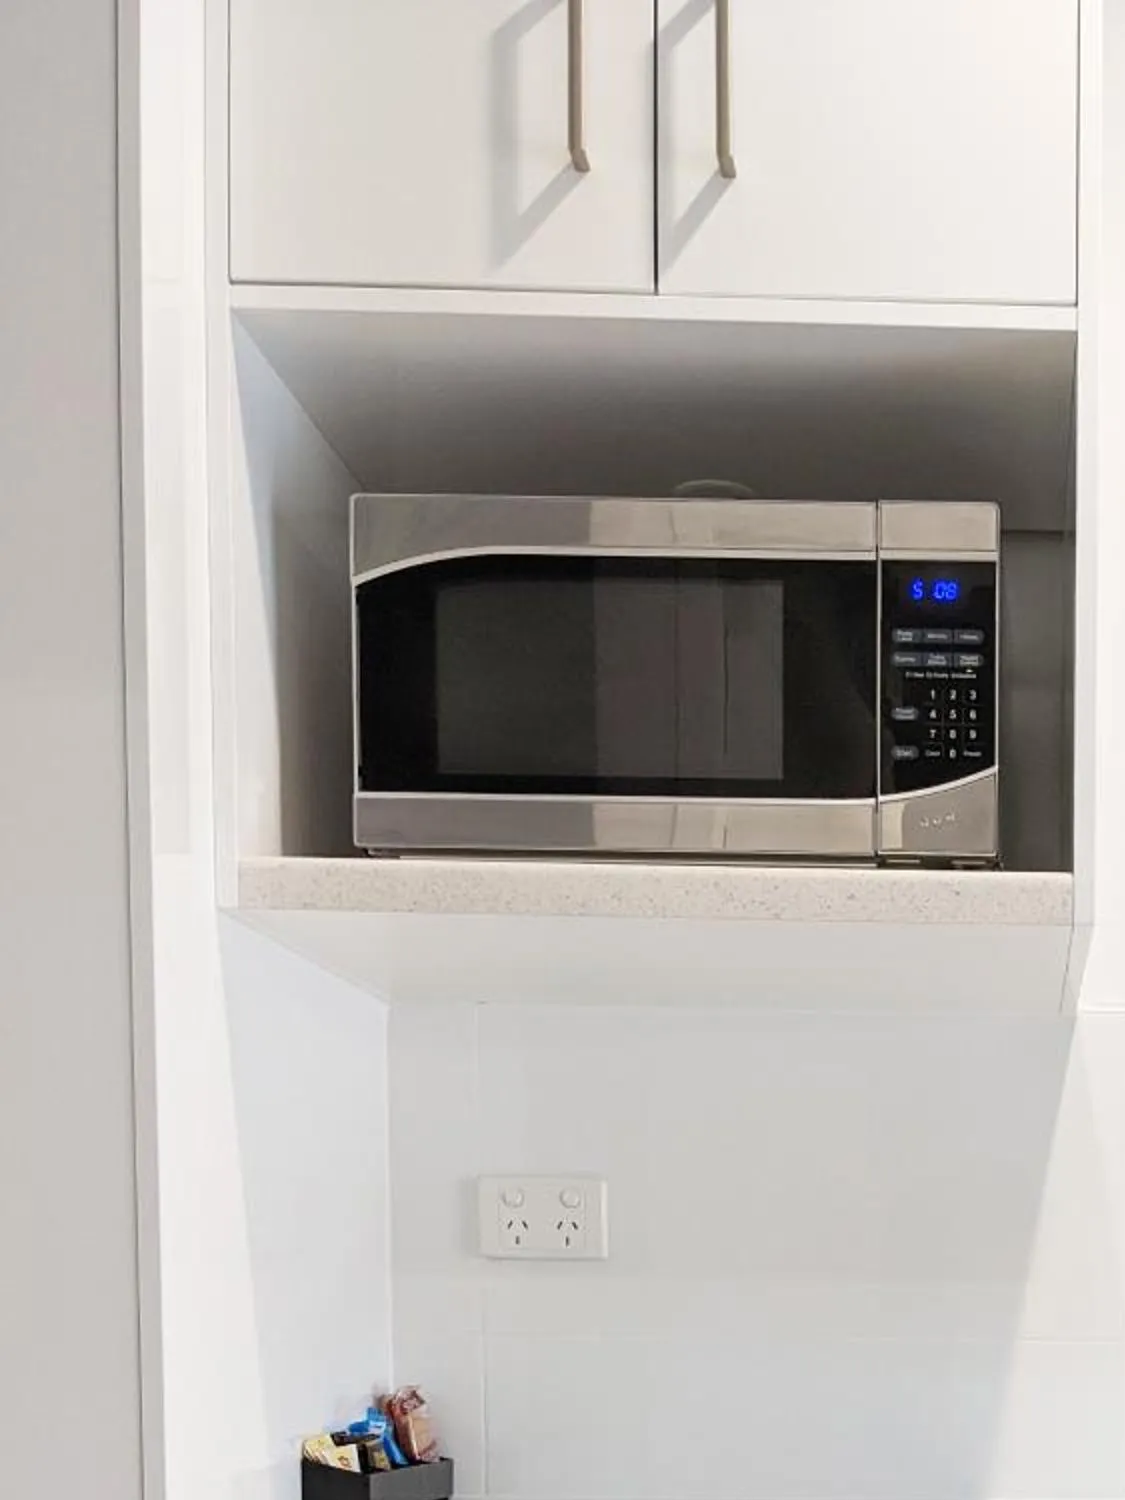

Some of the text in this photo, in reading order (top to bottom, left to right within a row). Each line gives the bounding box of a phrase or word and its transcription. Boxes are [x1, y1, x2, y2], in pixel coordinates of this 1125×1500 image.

[949, 689, 957, 701] 2
[969, 689, 977, 701] 3
[929, 709, 977, 720] 4 5 6
[929, 729, 977, 740] 7 8 9
[949, 748, 957, 759] 0
